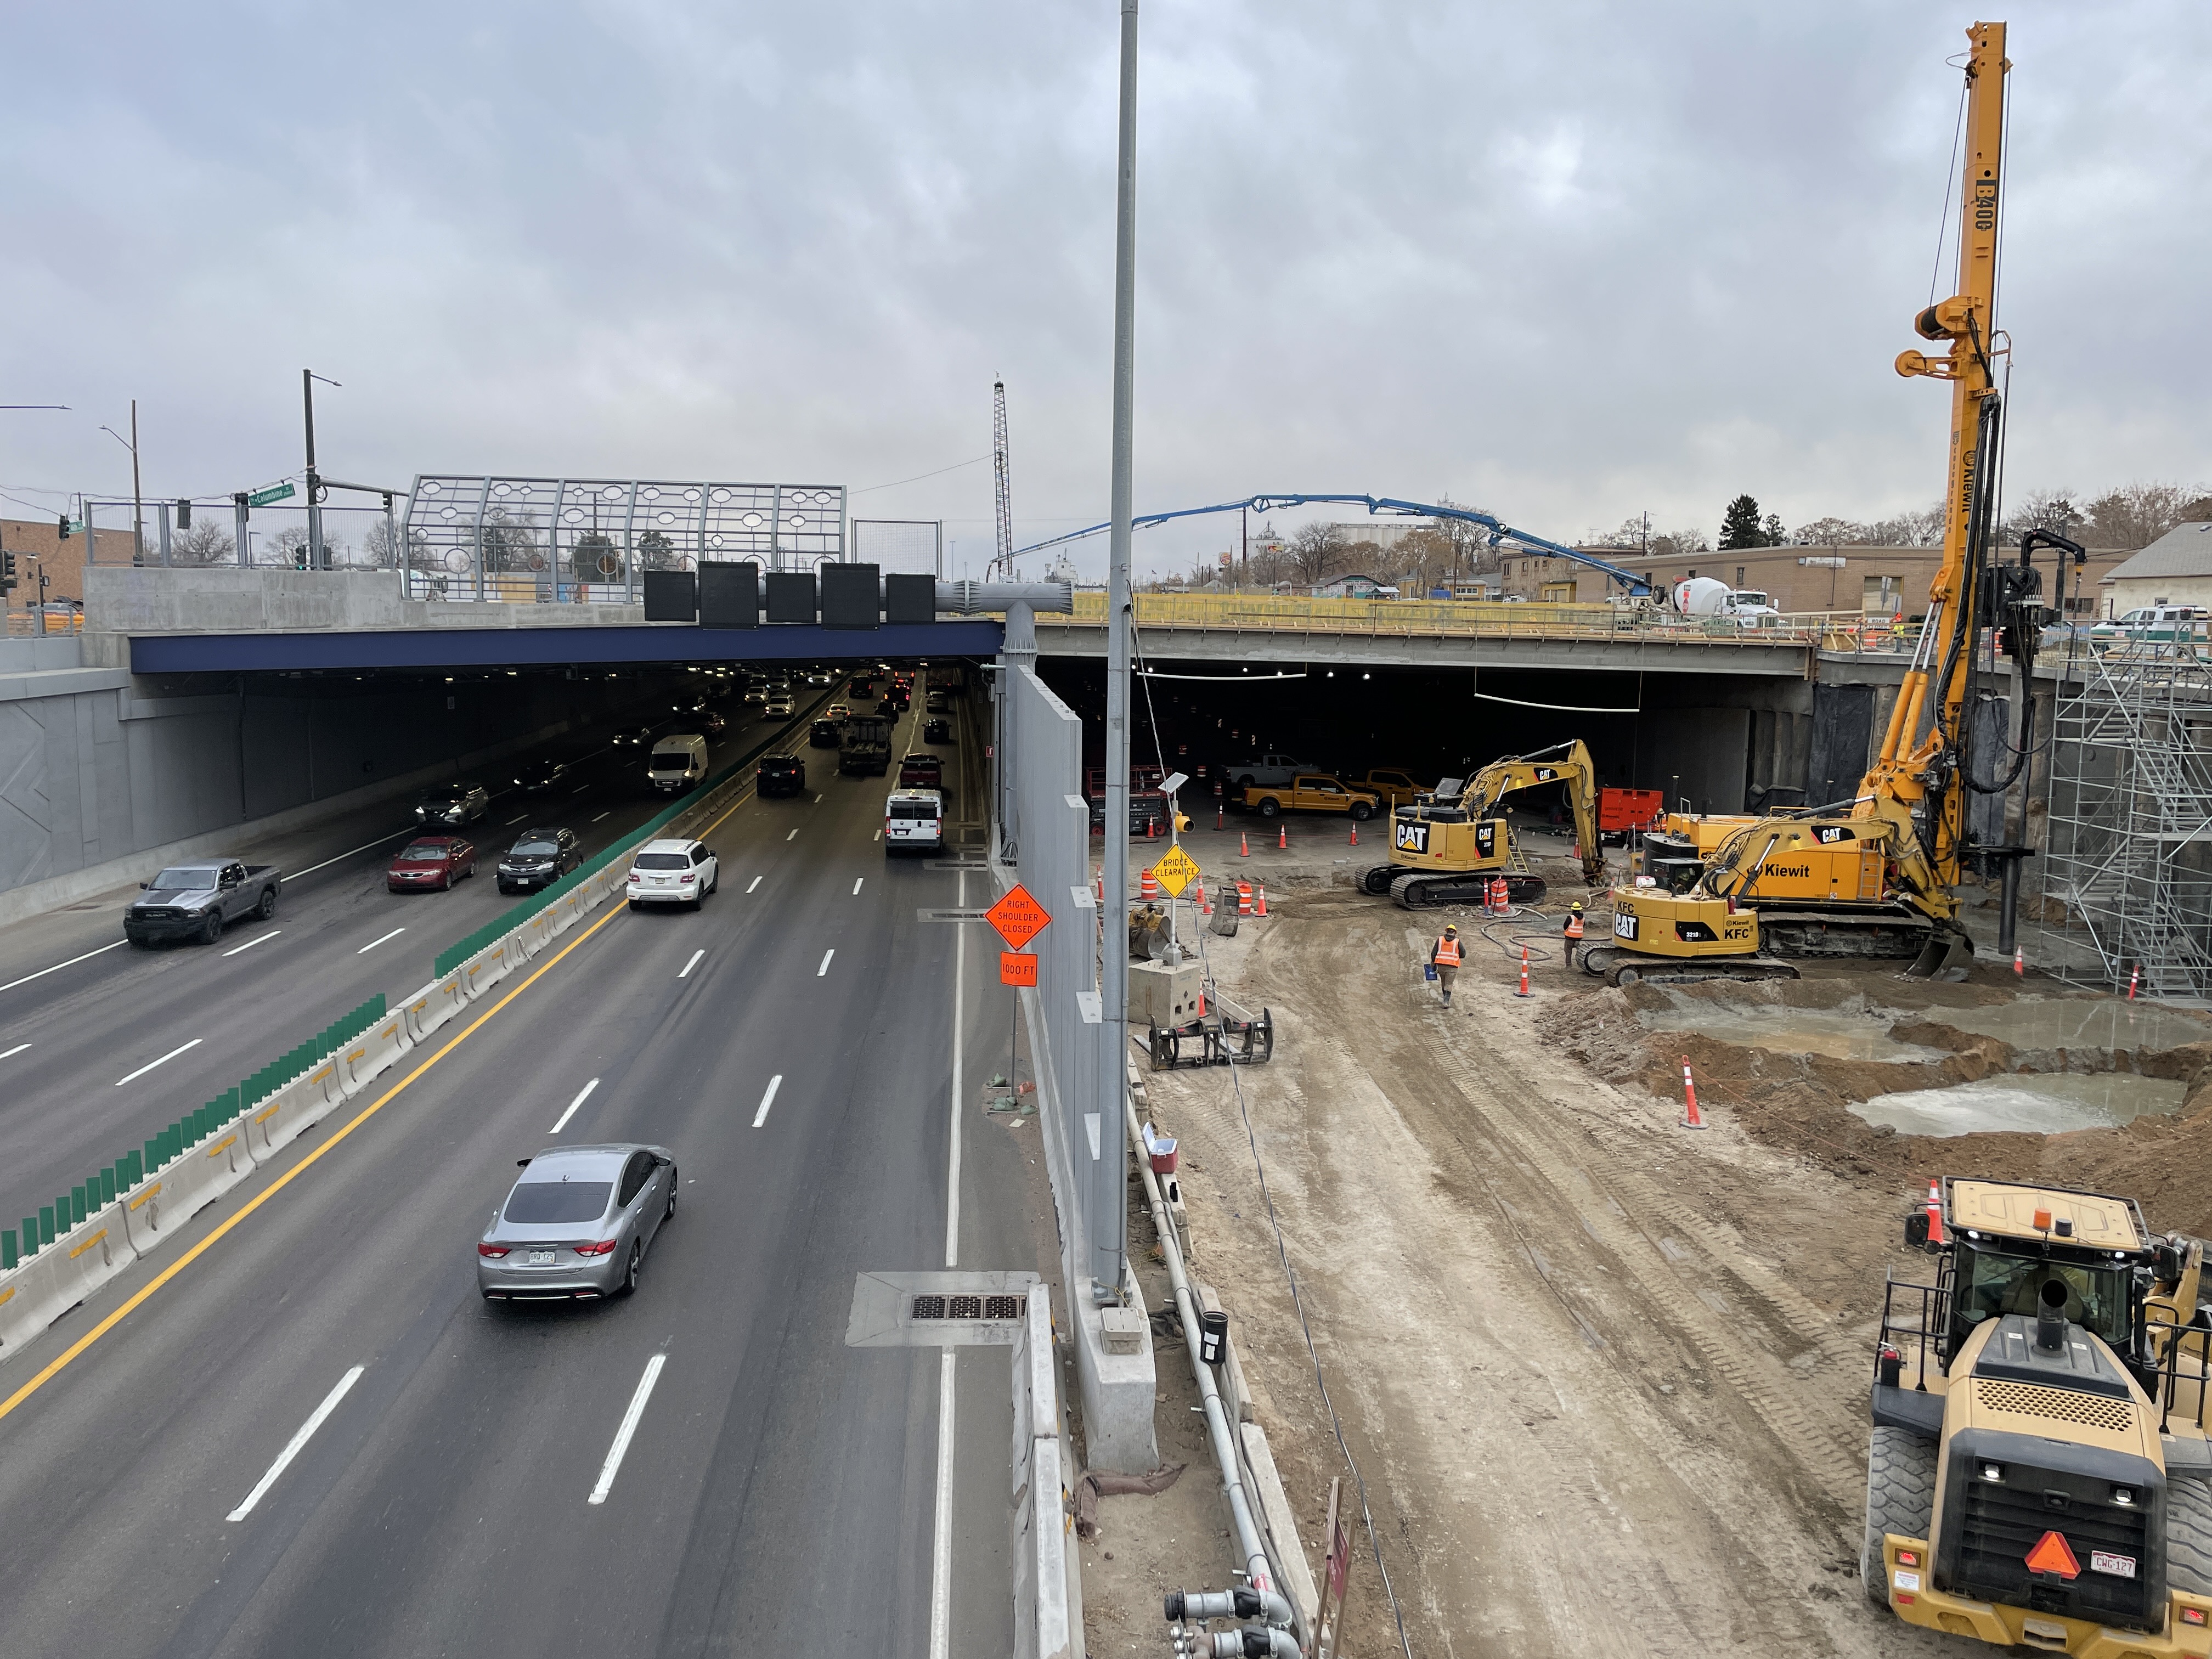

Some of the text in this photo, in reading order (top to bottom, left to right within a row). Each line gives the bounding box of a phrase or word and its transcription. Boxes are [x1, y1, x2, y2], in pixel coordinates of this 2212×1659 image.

[257, 490, 283, 503] Columbine
[1540, 769, 1550, 780] CAT
[1397, 825, 1426, 850] CAT
[1479, 828, 1492, 840] CAT
[1822, 828, 1841, 843] CAT
[1164, 859, 1188, 867] BRIDGE
[1765, 864, 1809, 877] Kiewit
[1007, 900, 1029, 909] RIGHT
[1618, 900, 1634, 913] KFC
[998, 912, 1039, 922] SHOULDER
[1003, 924, 1032, 933] CLOSED
[1616, 913, 1636, 939] CAT
[1725, 929, 1749, 939] KFC
[1003, 963, 1034, 975] 1000 FT
